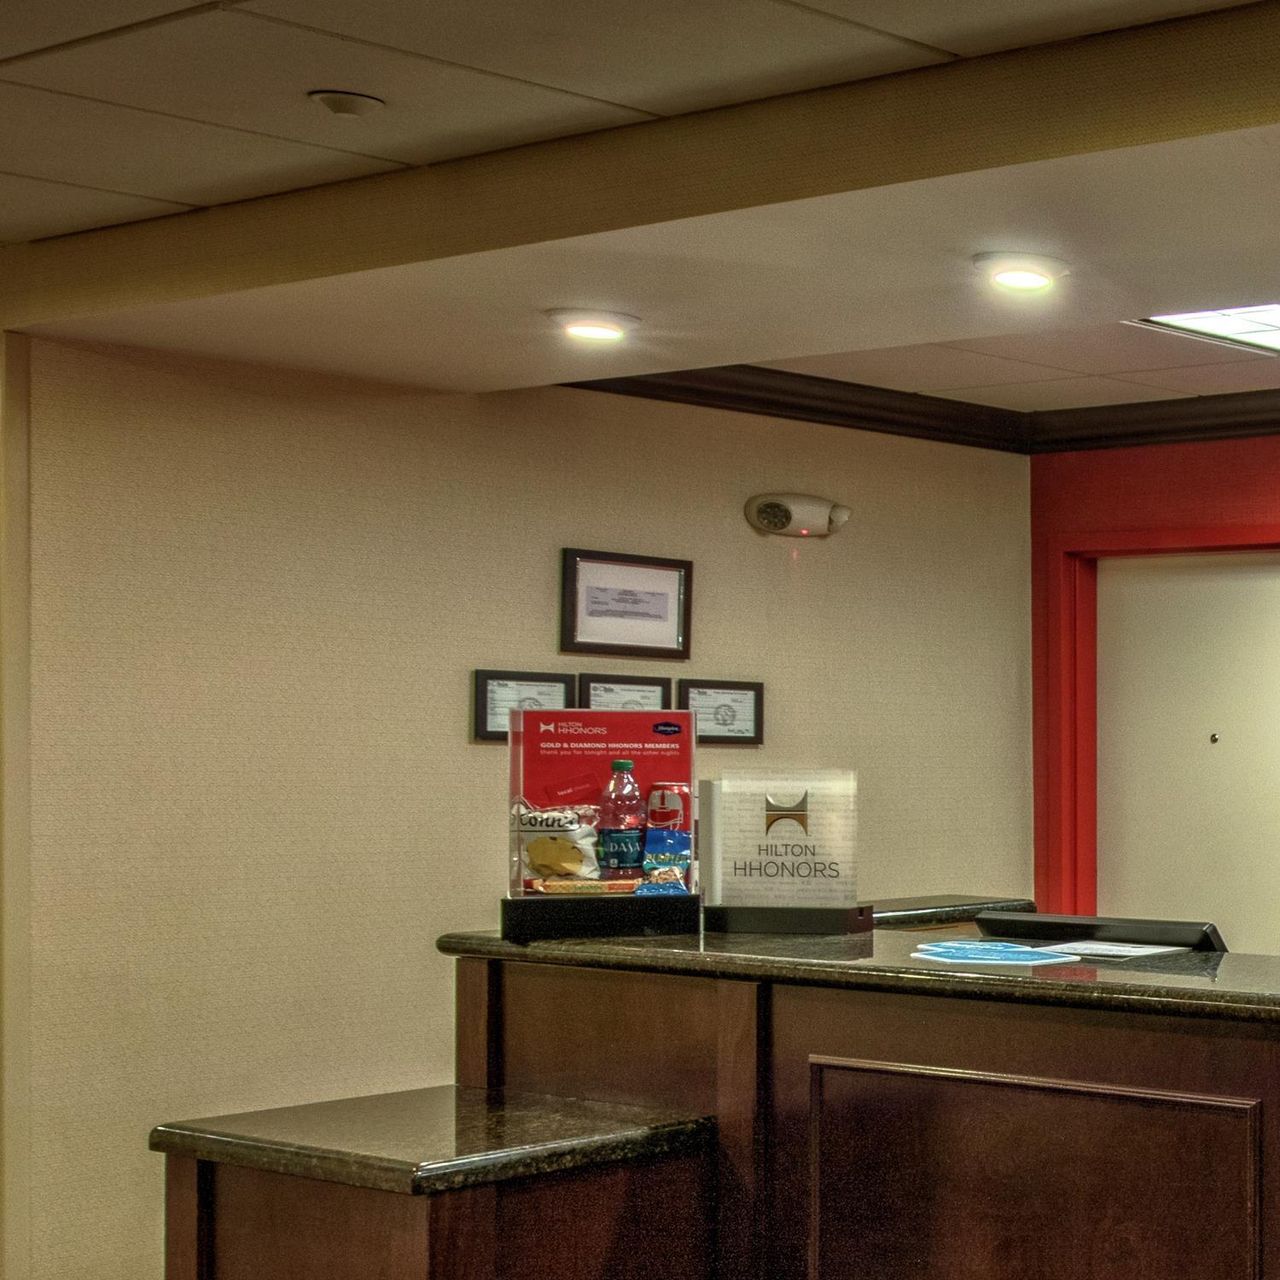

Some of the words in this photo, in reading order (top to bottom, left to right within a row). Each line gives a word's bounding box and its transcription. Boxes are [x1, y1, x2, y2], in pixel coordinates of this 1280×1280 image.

[558, 727, 608, 735] HHONORS
[758, 843, 816, 857] HILTON
[733, 861, 840, 879] HHONORS
